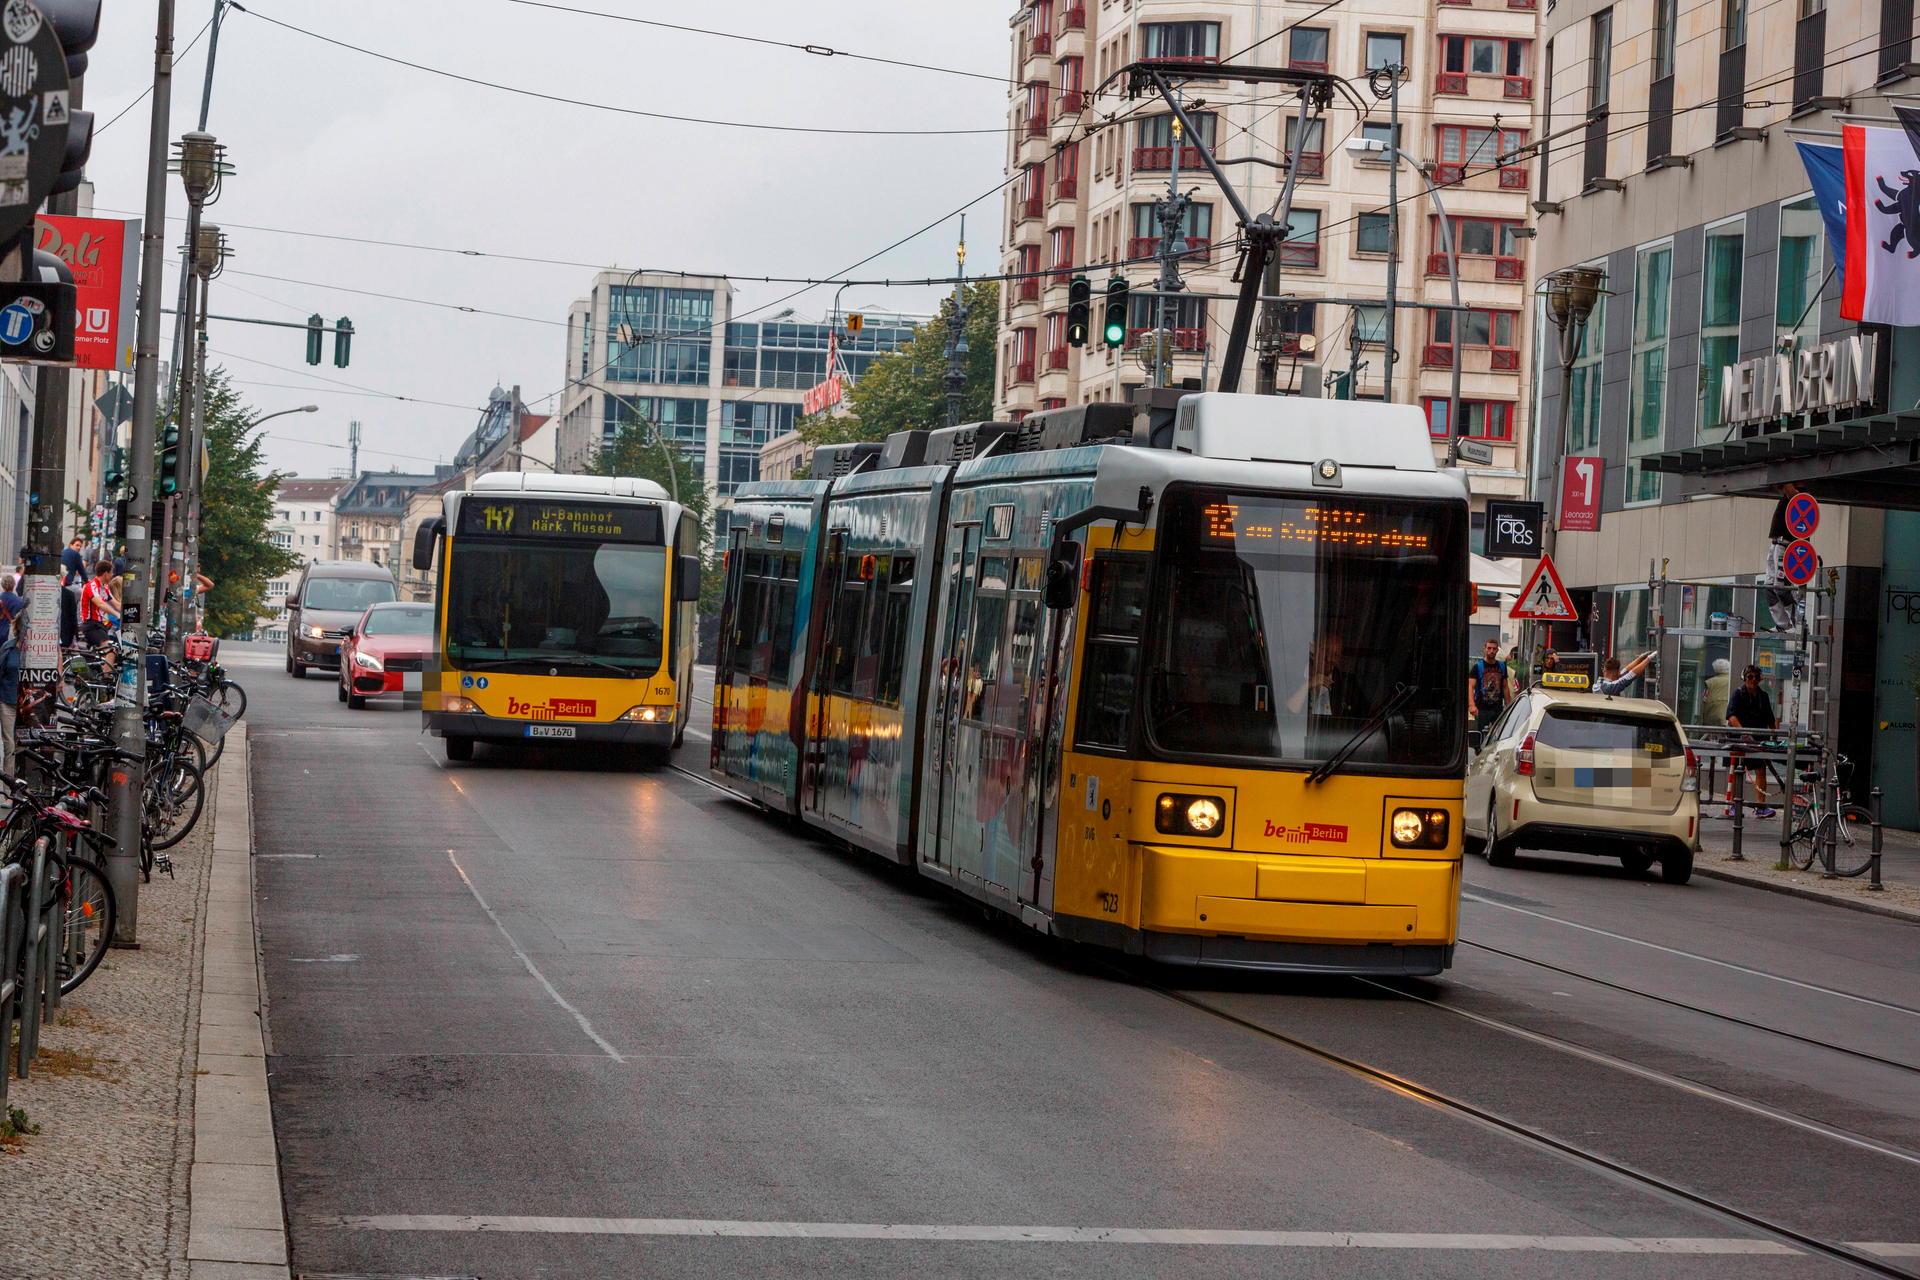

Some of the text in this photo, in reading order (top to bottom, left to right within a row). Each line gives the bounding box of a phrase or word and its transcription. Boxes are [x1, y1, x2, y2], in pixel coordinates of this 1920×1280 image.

[34, 218, 106, 267] Dalí
[849, 316, 858, 330] 1
[93, 336, 109, 344] Platz
[1795, 331, 1878, 416] BERLIN
[483, 506, 514, 531] 147
[542, 510, 613, 523] U-Bahnhof
[1565, 509, 1593, 519] Leonardo
[532, 519, 622, 535] Märk. Museum
[1551, 675, 1582, 684] TAXI
[654, 687, 670, 695] 1670
[507, 697, 592, 715] be Berlin
[1263, 819, 1344, 840] be Berlin
